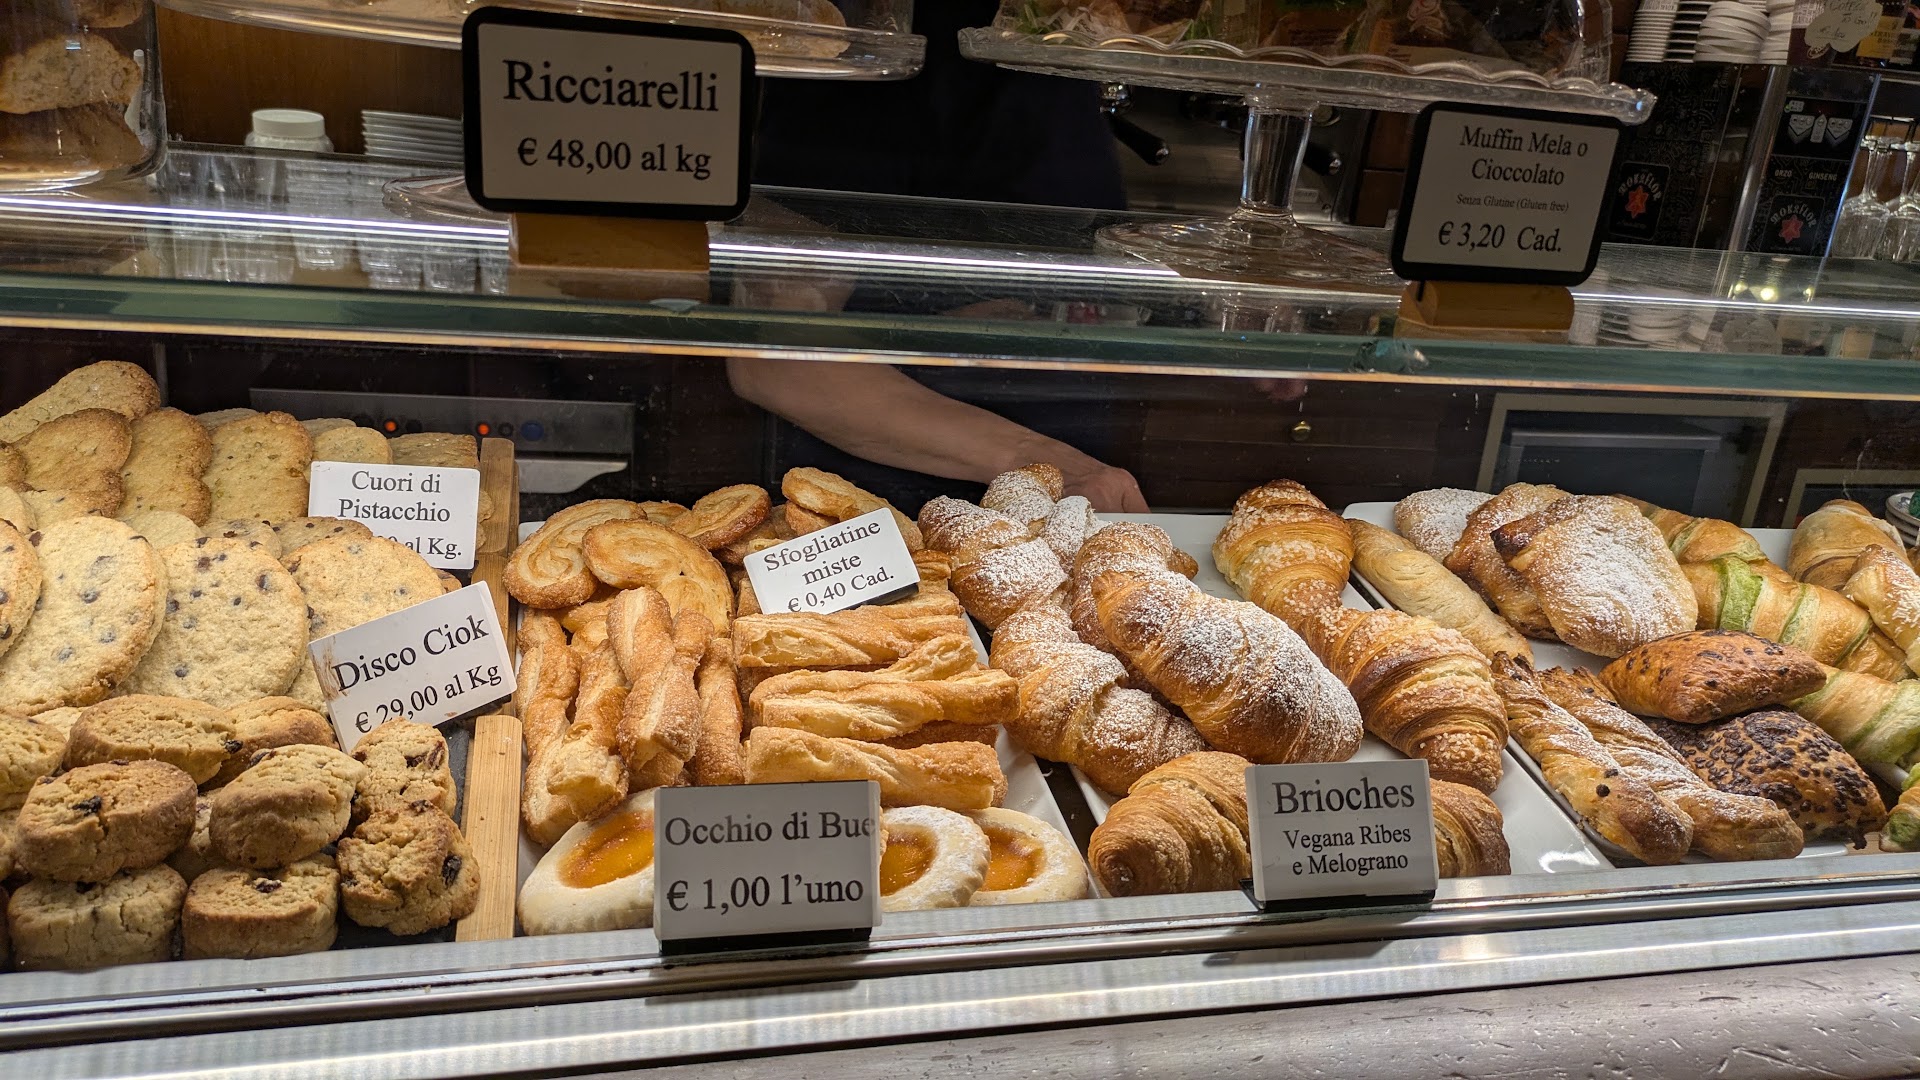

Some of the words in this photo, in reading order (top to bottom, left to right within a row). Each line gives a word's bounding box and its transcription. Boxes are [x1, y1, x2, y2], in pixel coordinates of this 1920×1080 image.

[502, 59, 719, 111] Ricciarelli
[1459, 126, 1523, 151] Muffin
[1528, 132, 1572, 156] Mela
[1577, 142, 1588, 157] o
[517, 137, 538, 166] €
[547, 138, 631, 175] 48,00
[641, 143, 667, 172] al
[675, 144, 711, 180] kg
[1472, 158, 1565, 186] Cioccolato
[1456, 193, 1481, 206] Senza
[1483, 195, 1515, 208] Glutine
[1516, 198, 1547, 211] (Gluten
[1549, 200, 1569, 212] free)
[1438, 220, 1454, 246] €
[1457, 222, 1505, 251] 3,20
[1517, 226, 1562, 252] Cad.
[351, 470, 413, 493] Cuori
[421, 474, 441, 493] di
[338, 499, 451, 522] Pistacchio
[427, 537, 462, 560] Kg.
[763, 521, 881, 572] Sfogliatine
[802, 554, 862, 585] miste
[787, 597, 802, 613] €
[805, 582, 846, 607] 0,40
[851, 566, 894, 591] Cad.
[331, 645, 417, 692] Disco
[423, 615, 490, 656] Ciok
[355, 711, 372, 734] €
[376, 685, 439, 722] 29,00
[444, 676, 465, 699] al
[468, 665, 502, 690] Kg
[1272, 777, 1415, 815] Brioches
[664, 814, 773, 846] Occhio
[782, 811, 810, 841] di
[818, 811, 876, 839] Bue
[1283, 829, 1355, 853] Vegana
[1359, 824, 1412, 845] Ribes
[1292, 860, 1303, 876] e
[1307, 853, 1409, 877] Melograno
[666, 880, 689, 911] €
[703, 876, 770, 915] 1,00
[780, 874, 864, 905] l'uno
